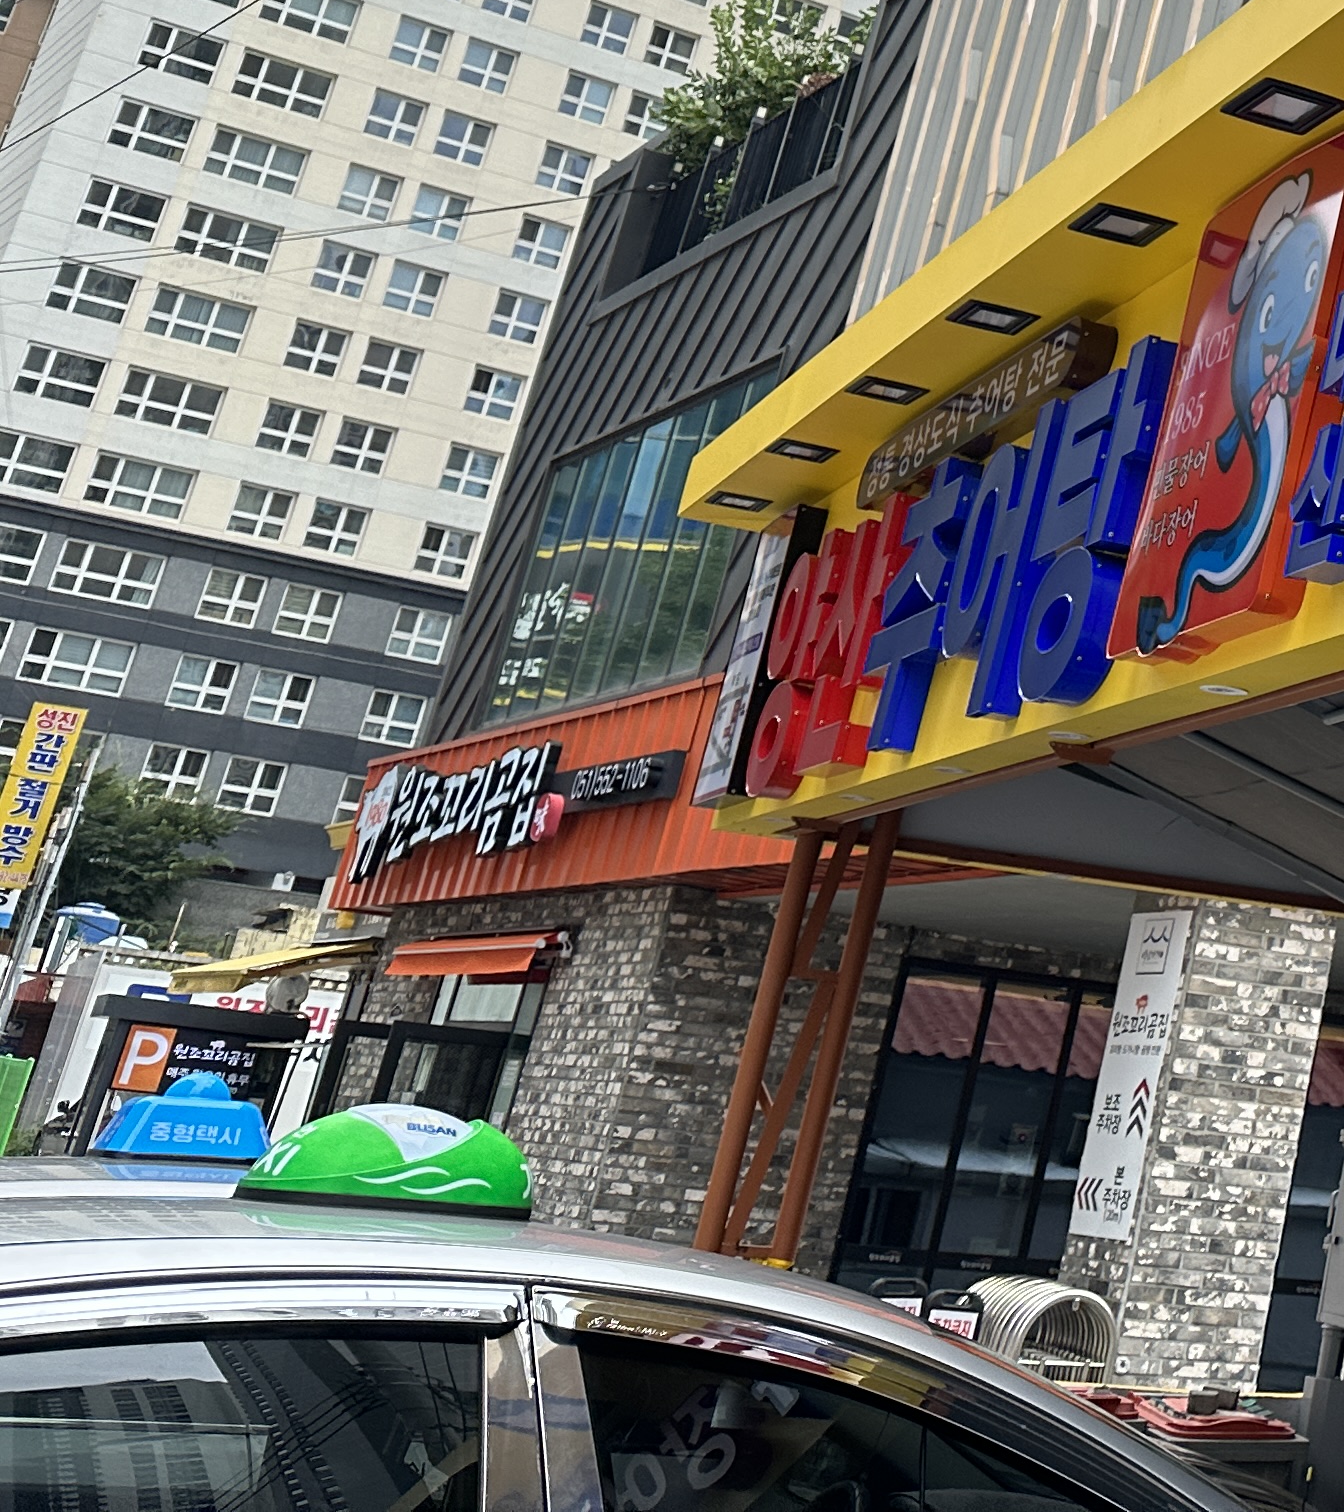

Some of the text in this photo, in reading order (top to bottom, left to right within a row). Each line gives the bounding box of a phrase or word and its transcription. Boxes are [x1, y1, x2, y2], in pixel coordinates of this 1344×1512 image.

[1179, 323, 1237, 388] SINCE
[899, 399, 965, 478] 경상도식
[966, 357, 1023, 434] 추어탕
[1025, 330, 1069, 398] 전문
[1164, 390, 1207, 445] 1985
[1153, 440, 1211, 500] 민물장어
[36, 708, 80, 733] 성진
[27, 732, 65, 773] 간판
[570, 757, 653, 800] 051)552-1106
[0, 824, 33, 867] 방수
[118, 1030, 169, 1085] P
[1104, 1093, 1122, 1112] 보조
[150, 1121, 242, 1146] 중형택시
[406, 1121, 458, 1138] BUSAN
[1096, 1113, 1122, 1135] 주차장
[1102, 1188, 1131, 1211] 주차장
